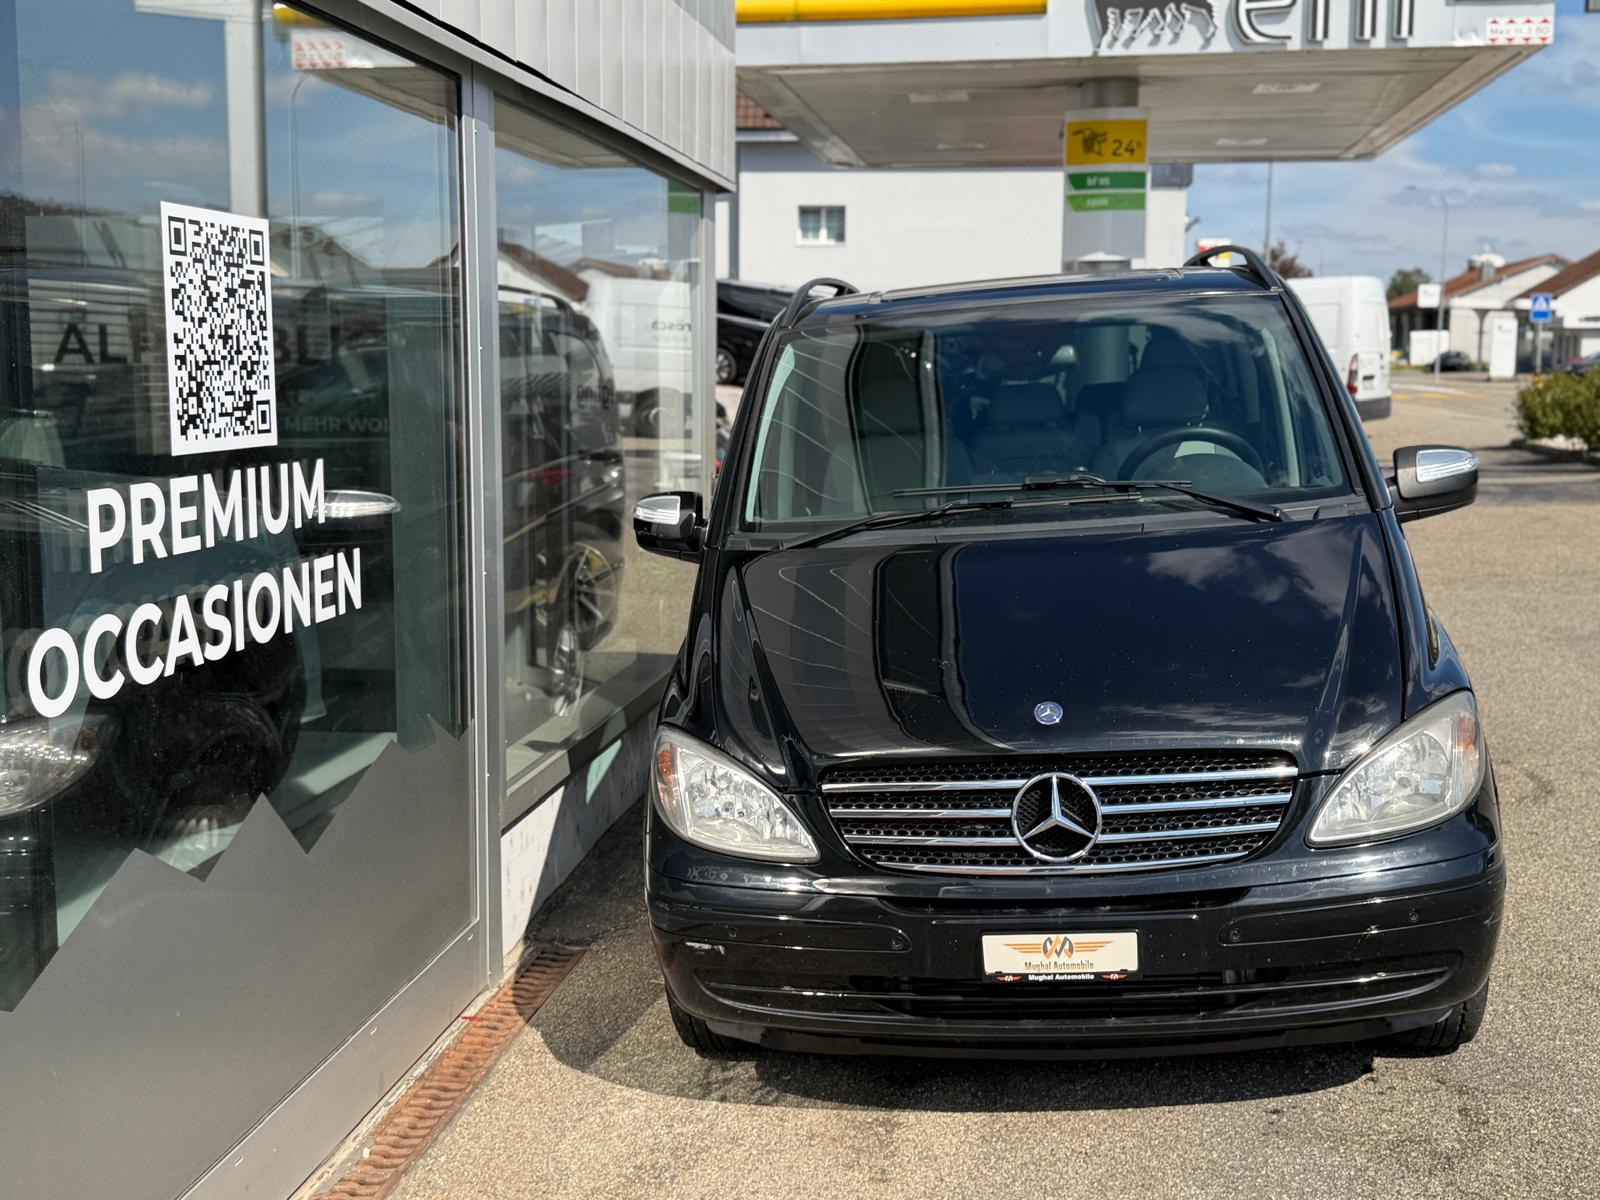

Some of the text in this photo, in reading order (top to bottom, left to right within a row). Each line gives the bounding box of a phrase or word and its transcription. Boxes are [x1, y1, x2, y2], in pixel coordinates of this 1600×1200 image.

[87, 458, 326, 574] PREMIUM
[27, 548, 362, 718] OCCASIONEN
[1024, 960, 1094, 972] Mughal Automobile
[1028, 973, 1095, 982] Mughal Automobile
